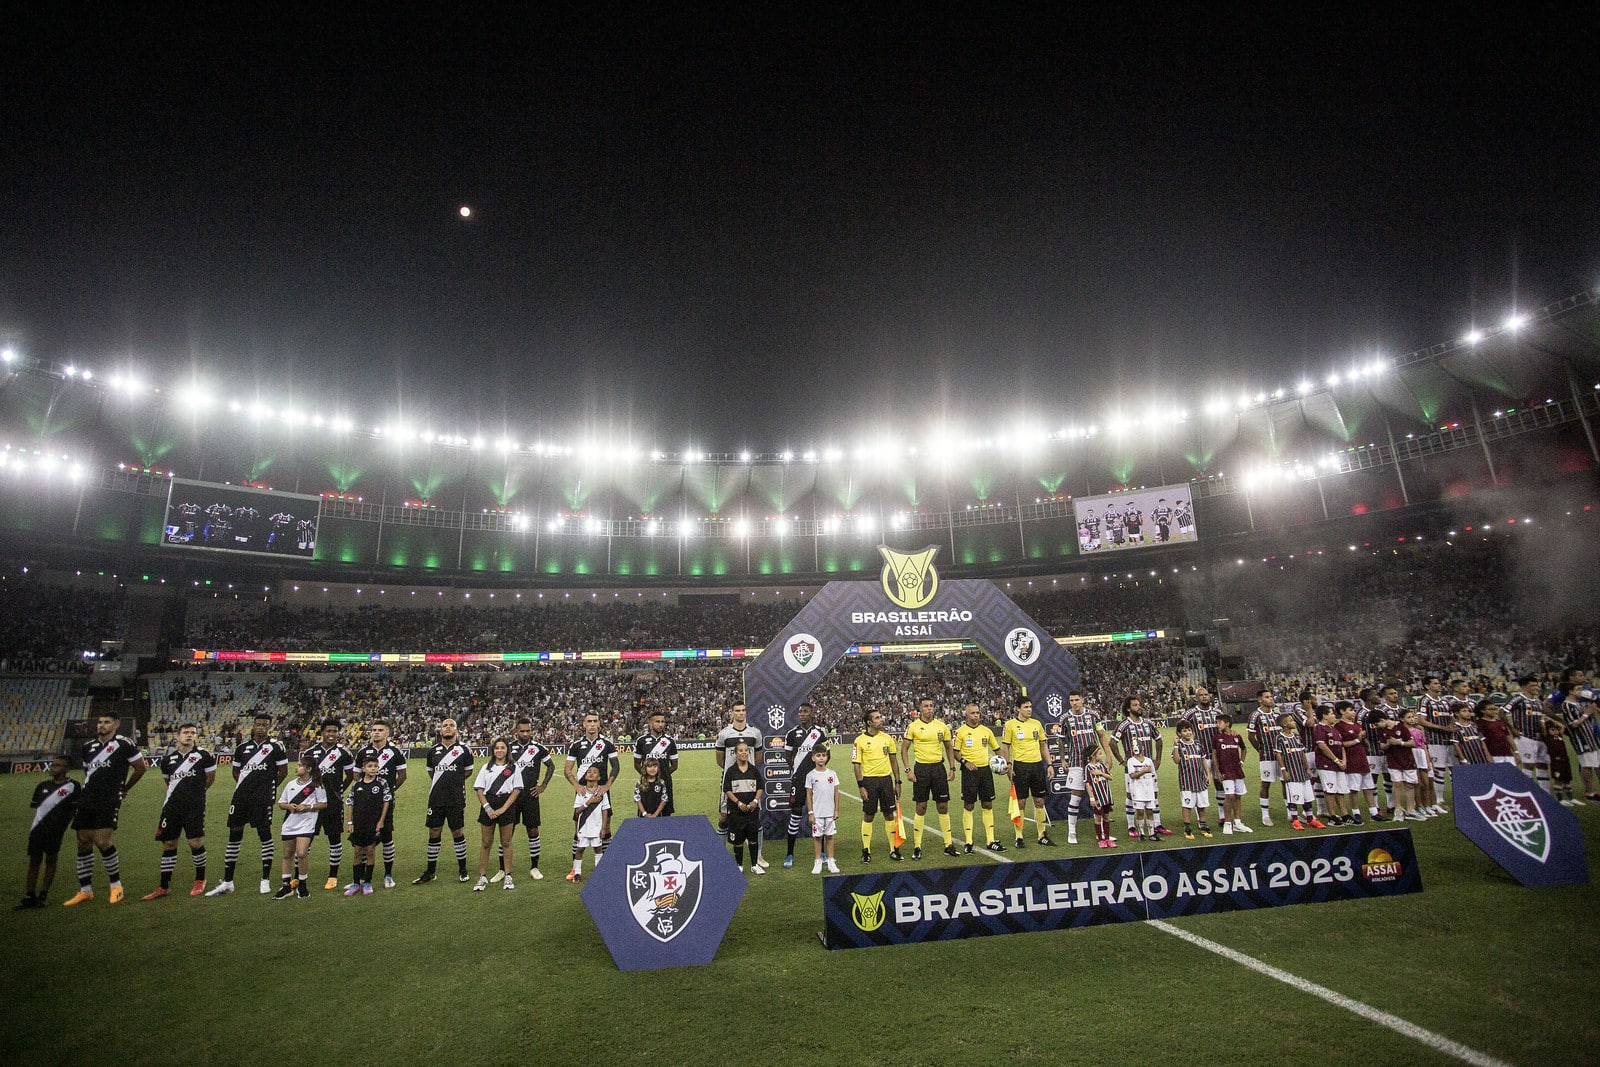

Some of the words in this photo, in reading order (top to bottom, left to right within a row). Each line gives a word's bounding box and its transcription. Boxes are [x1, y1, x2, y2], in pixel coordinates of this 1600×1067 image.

[851, 608, 973, 624] BRASILEIRÃO
[895, 625, 932, 636] ASSAÍ
[894, 870, 1168, 923] BRASILEIRÃO
[1176, 863, 1259, 898] ASSAÍ
[1267, 856, 1354, 889] 2023
